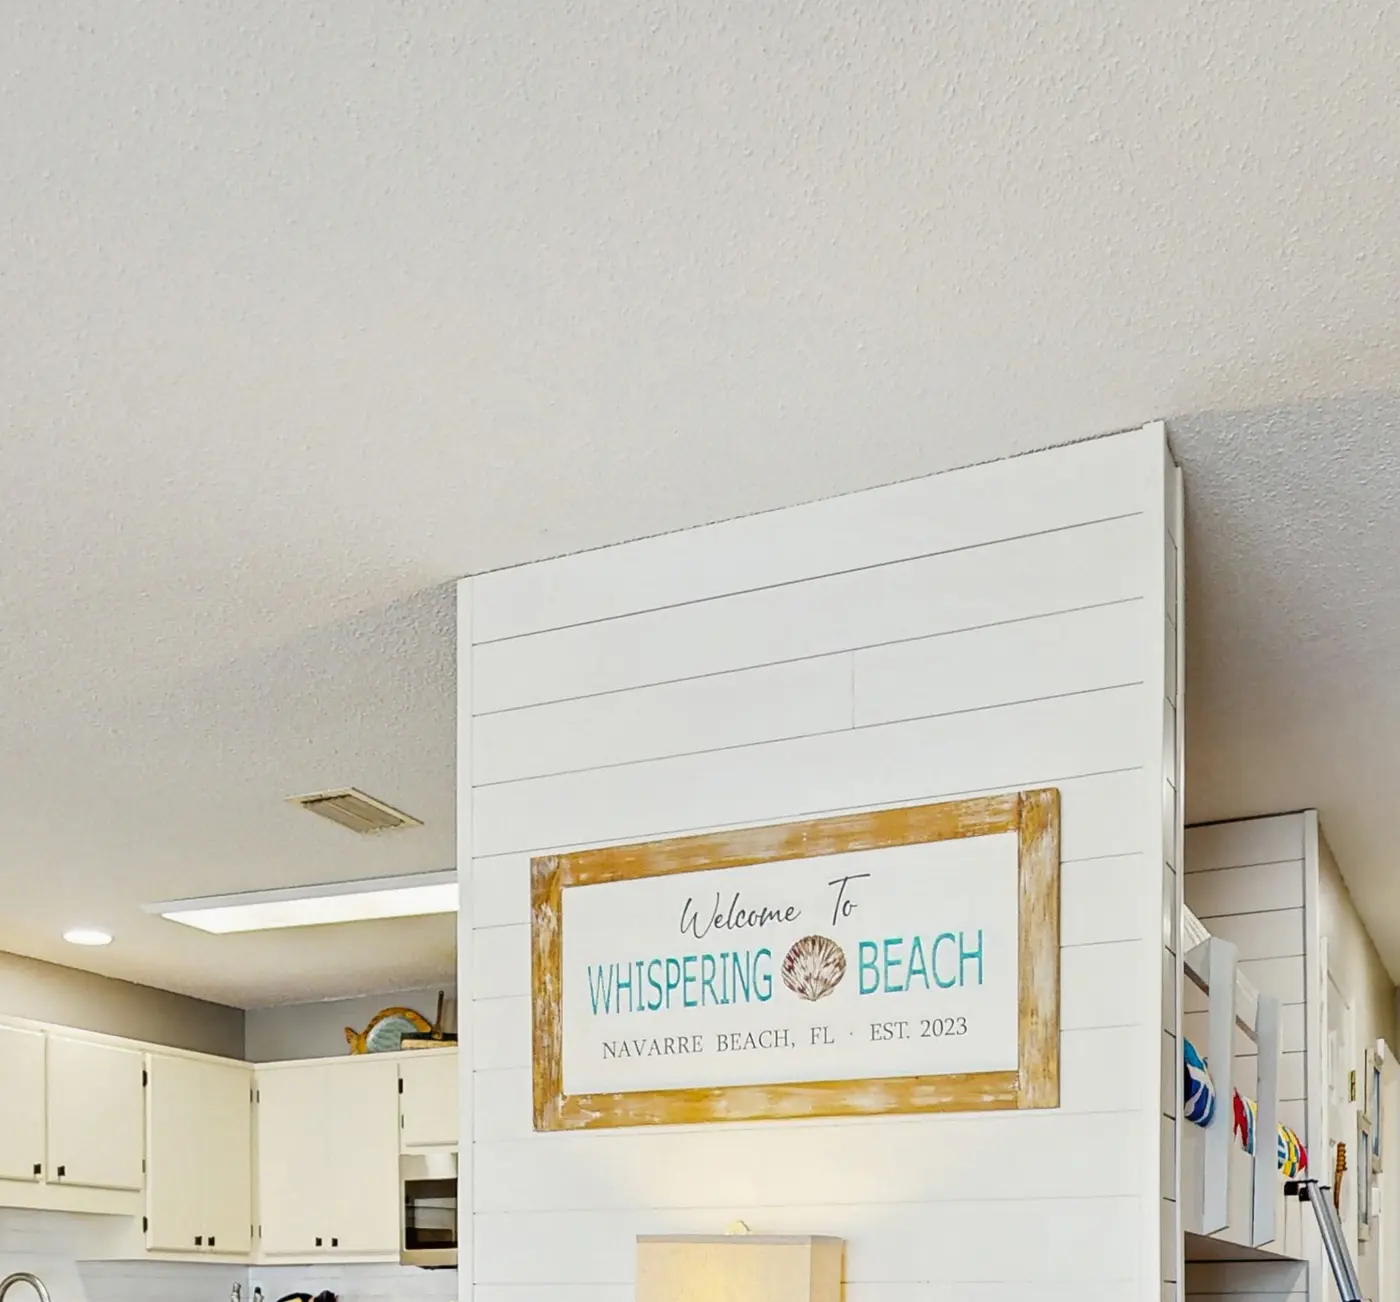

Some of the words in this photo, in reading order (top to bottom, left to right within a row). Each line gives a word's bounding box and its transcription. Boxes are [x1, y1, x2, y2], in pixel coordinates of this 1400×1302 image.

[680, 891, 802, 939] Welcome
[828, 873, 871, 926] To
[587, 947, 773, 1016] WHISPERING
[858, 928, 984, 996] BEACH
[602, 1035, 704, 1060] NAVARRE
[716, 1028, 796, 1051] BEACH,
[810, 1025, 835, 1046] FL
[869, 1020, 911, 1042] EST.
[920, 1016, 968, 1038] 2023
